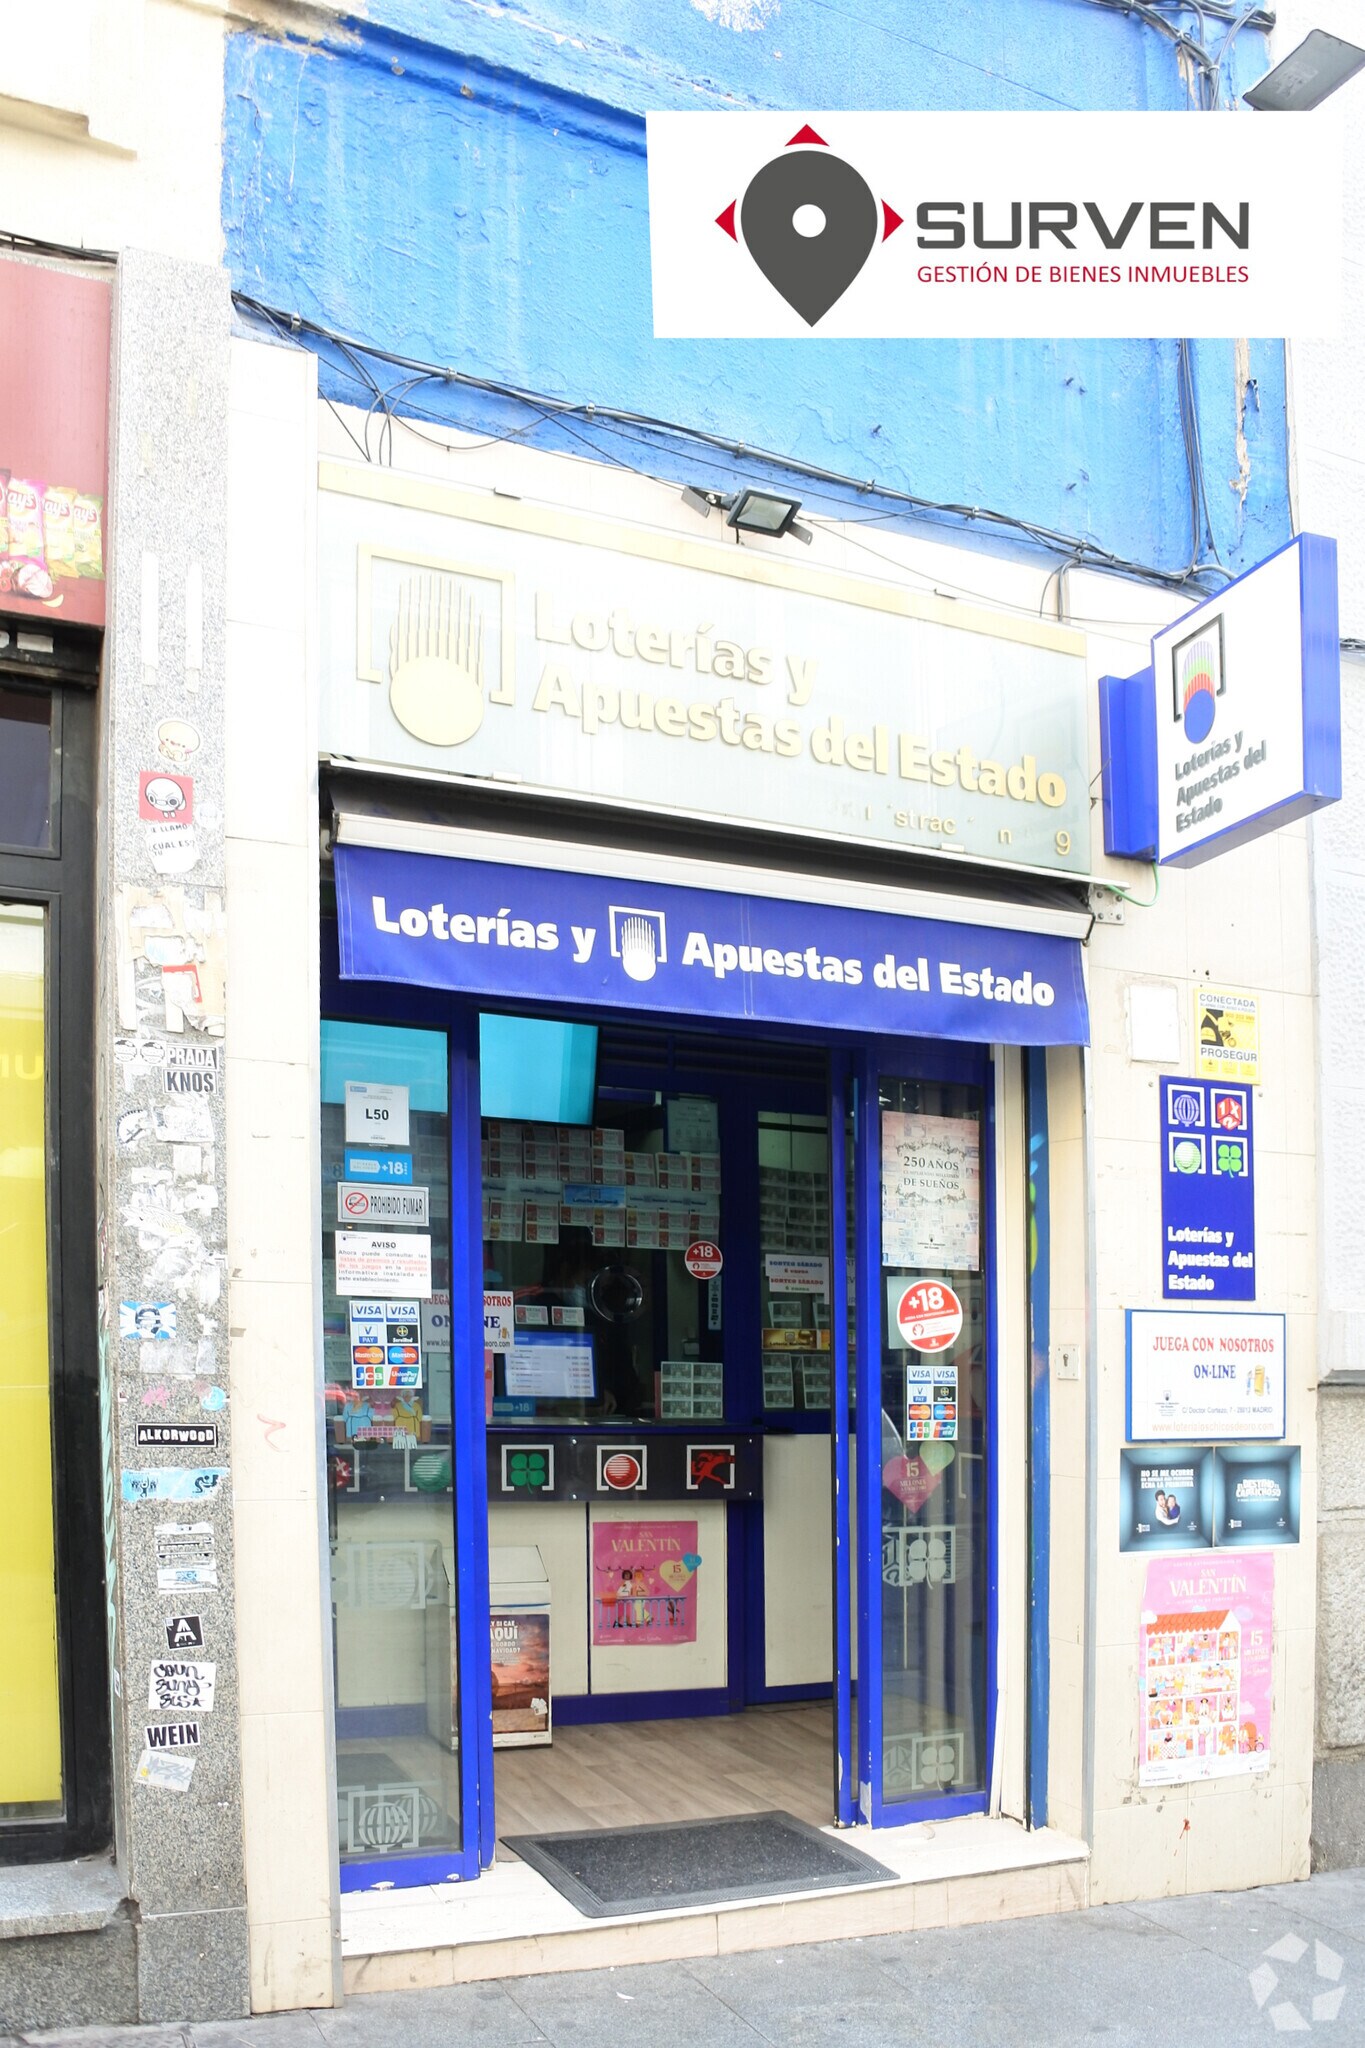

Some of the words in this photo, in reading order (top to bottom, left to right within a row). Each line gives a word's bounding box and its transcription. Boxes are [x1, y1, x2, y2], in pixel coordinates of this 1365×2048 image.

[535, 591, 775, 686] Loterías
[786, 654, 818, 706] y
[533, 663, 802, 757] Apuestas
[810, 716, 889, 776] del
[899, 732, 1068, 808] Estado
[1175, 741, 1231, 782] Loterías
[1235, 730, 1244, 753] y
[1176, 759, 1240, 807] Apuestas
[1243, 740, 1267, 770] del
[1176, 795, 1223, 834] Estado
[1055, 830, 1072, 855] 9
[372, 895, 559, 951] Loterías
[571, 925, 597, 964] y
[682, 931, 863, 986] Apuestas
[873, 953, 930, 992] del
[940, 960, 1056, 1008] Estado
[1199, 993, 1256, 1009] CONECTADA
[168, 1047, 215, 1067] PRADA
[1200, 1047, 1257, 1062] PROSEGUR
[166, 1071, 214, 1093] KNOS
[365, 1108, 390, 1121] L50
[381, 1161, 405, 1176] +18
[903, 1155, 925, 1168] 250
[927, 1157, 959, 1171] AÑOS
[903, 1178, 917, 1187] DE
[919, 1178, 960, 1190] SUEÑOS
[370, 1195, 401, 1215] PROHIBIDO
[402, 1197, 423, 1216] FUMAR
[1167, 1225, 1223, 1244] Loterías
[1224, 1230, 1235, 1248] y
[371, 1241, 397, 1249] AVISO
[692, 1245, 714, 1258] +18
[1167, 1250, 1230, 1270] Apuestas
[1232, 1251, 1254, 1269] del
[1168, 1274, 1215, 1291] Estado
[484, 1296, 512, 1307] SOTROS
[908, 1286, 945, 1312] +18
[355, 1306, 382, 1316] VISA
[390, 1306, 416, 1316] VISA
[1152, 1336, 1190, 1352] JUEGA
[1192, 1337, 1215, 1352] CON
[1219, 1337, 1275, 1353] NOSOTROS
[911, 1370, 931, 1379] VISA
[936, 1370, 956, 1379] VISA
[1252, 1406, 1273, 1414] MADRID
[139, 1428, 214, 1443] ALKORWOOD
[905, 1462, 920, 1477] 15
[1140, 1469, 1150, 1478] NO
[1151, 1469, 1159, 1477] SE
[1170, 1468, 1194, 1477] OCURRE
[611, 1536, 681, 1552] VALENTÍN
[672, 1564, 682, 1574] 15
[1169, 1574, 1247, 1597] VALENTÍN
[1250, 1629, 1263, 1647] 15
[147, 1723, 199, 1748] WEIN
